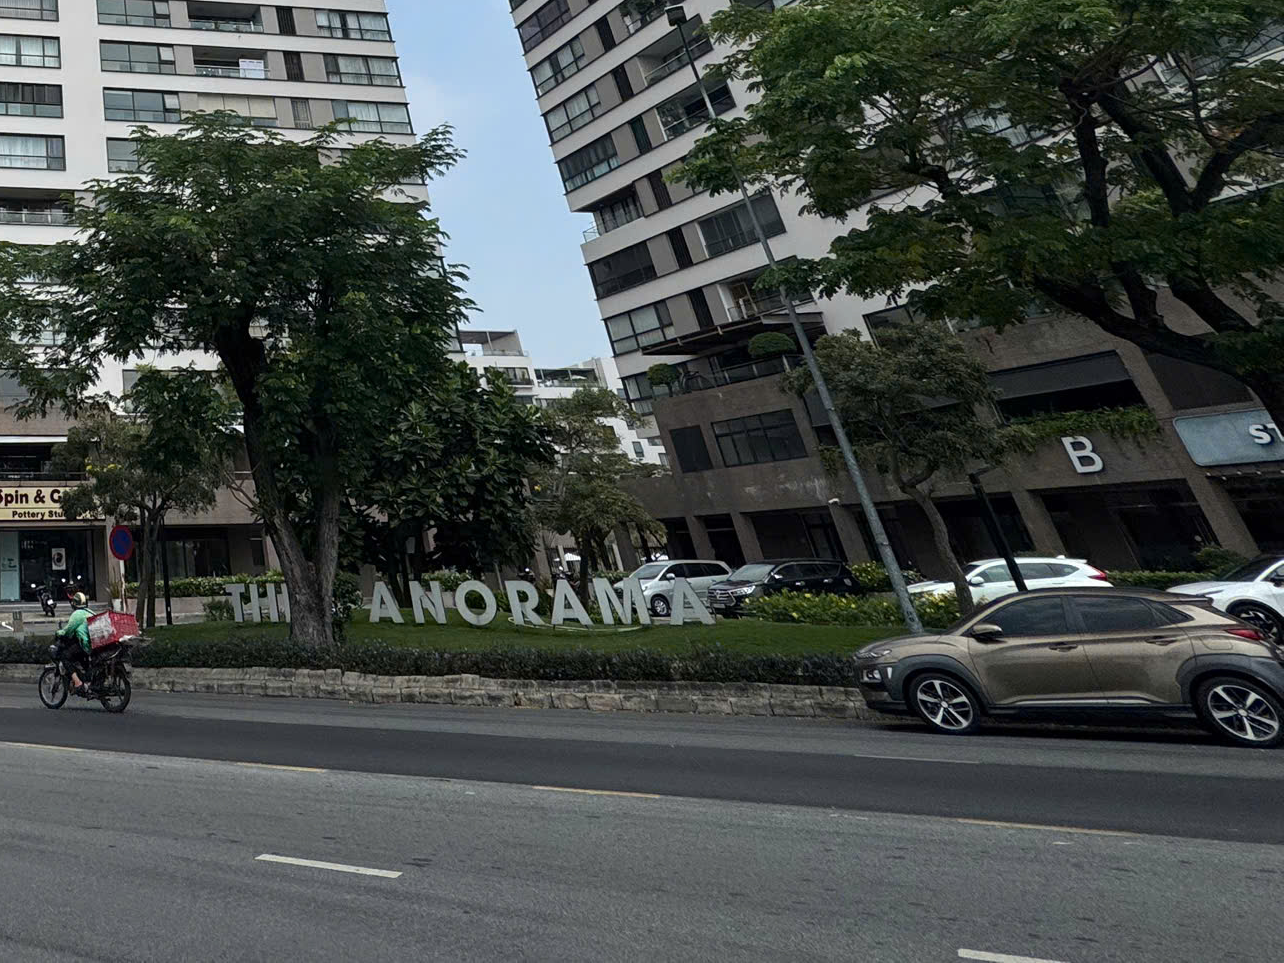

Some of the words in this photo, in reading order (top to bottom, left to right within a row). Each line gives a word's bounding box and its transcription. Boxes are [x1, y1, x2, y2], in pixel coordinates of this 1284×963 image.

[1061, 436, 1103, 473] B
[34, 489, 45, 504] &
[12, 510, 45, 520] Pottery
[48, 510, 65, 518] Stu
[369, 577, 716, 626] ANORAMA
